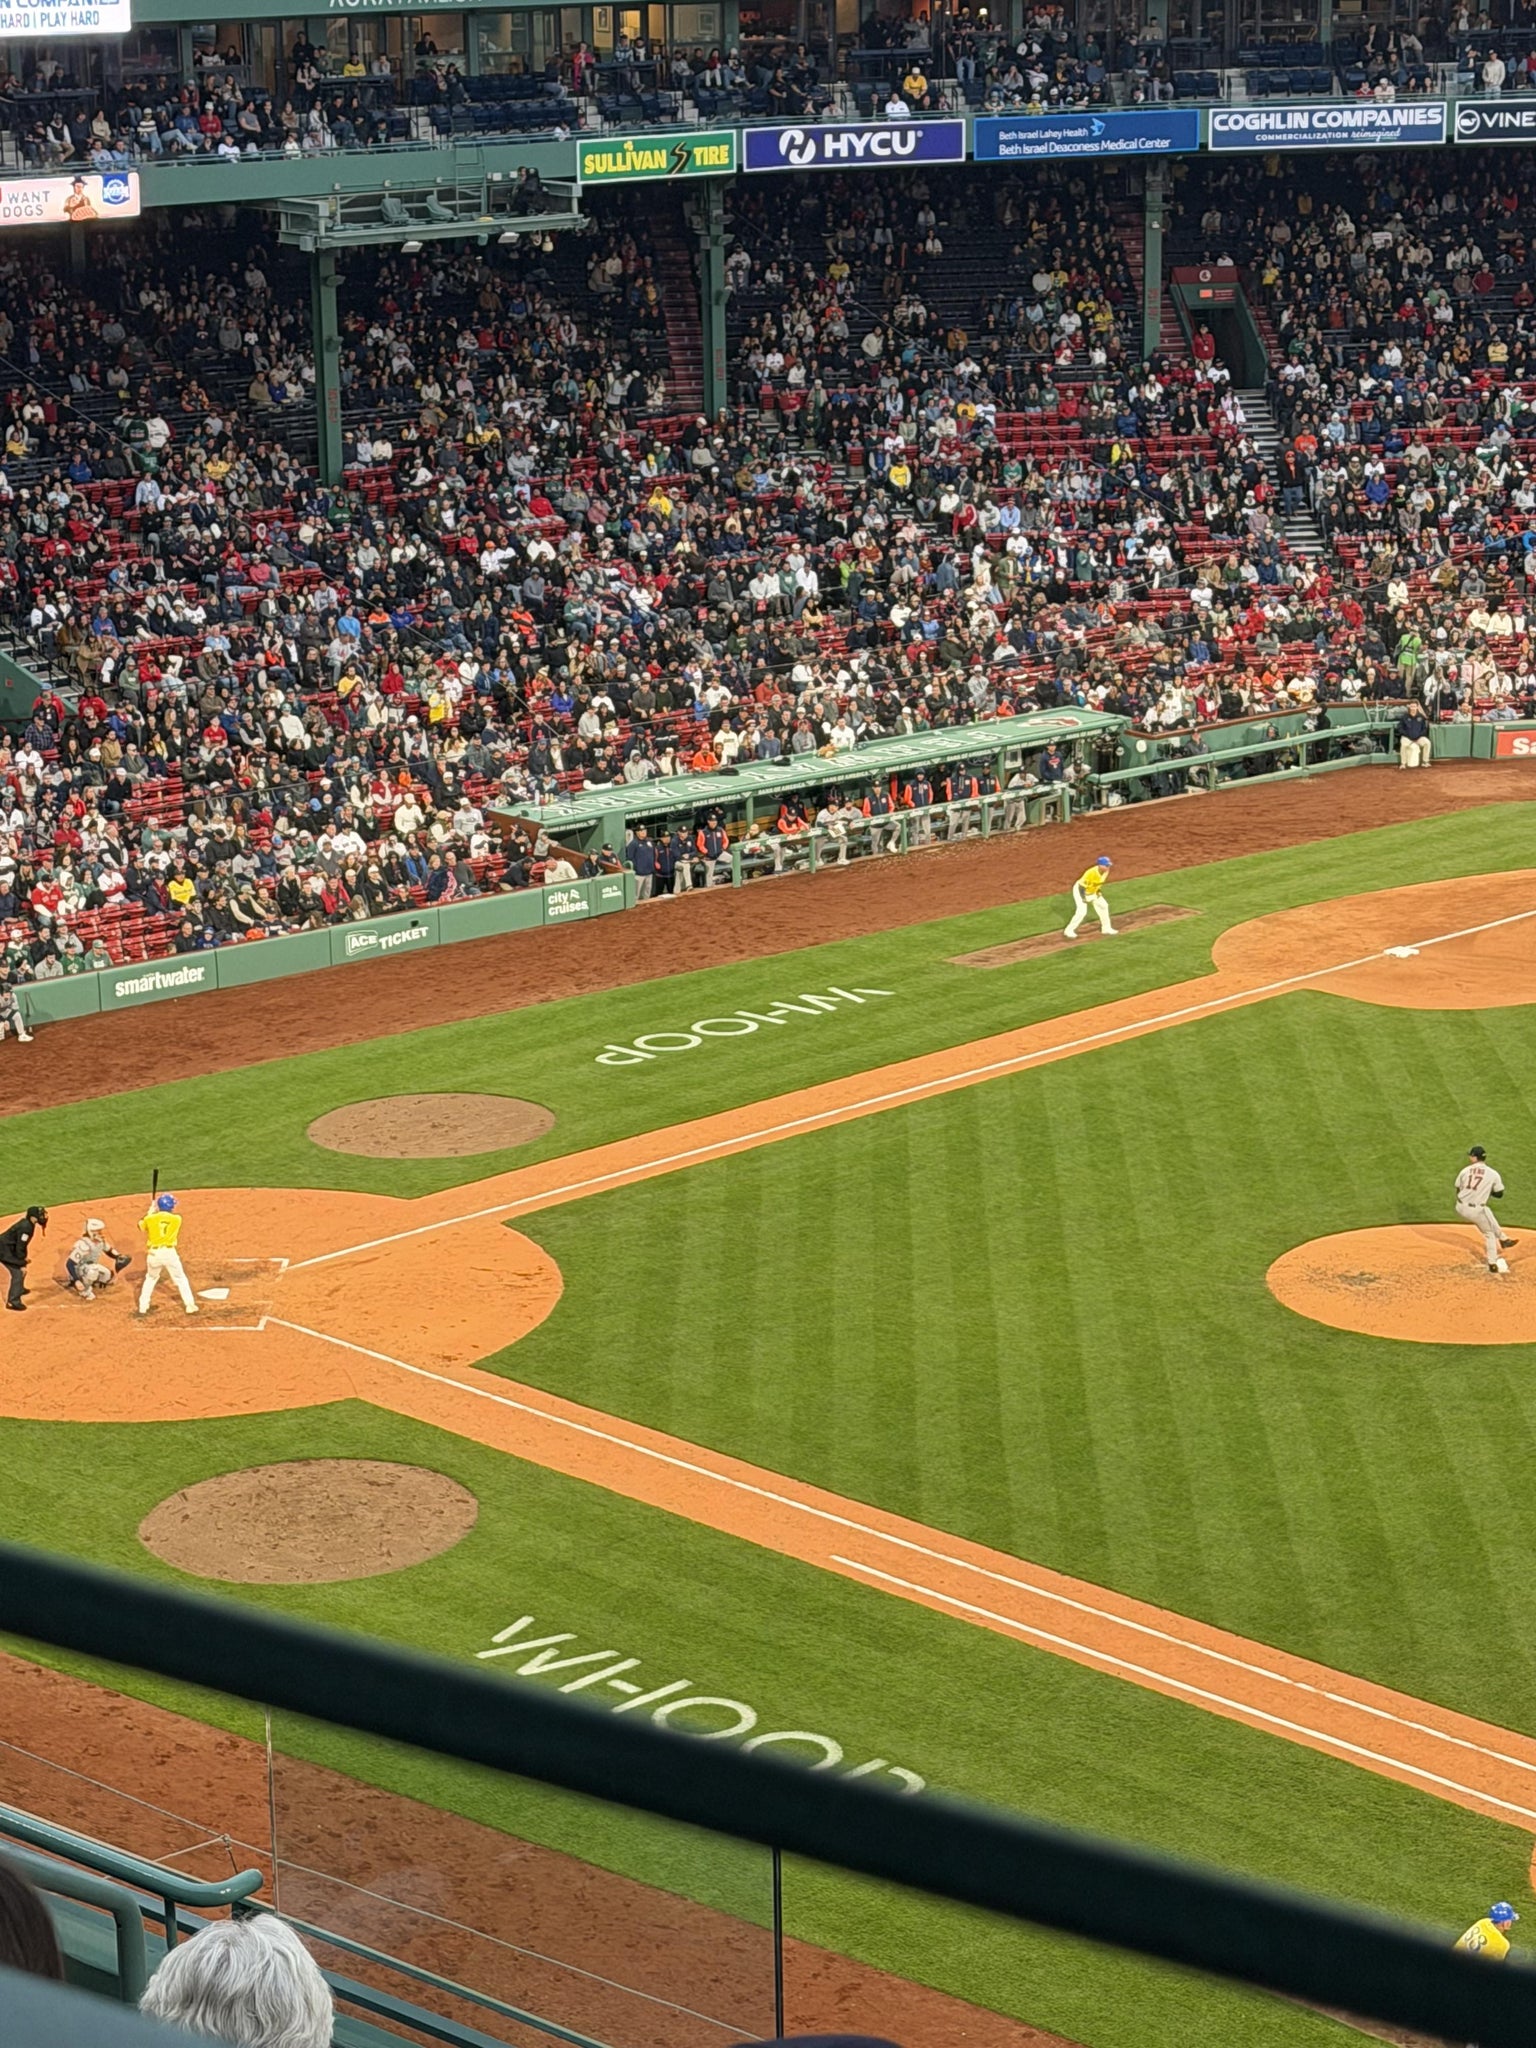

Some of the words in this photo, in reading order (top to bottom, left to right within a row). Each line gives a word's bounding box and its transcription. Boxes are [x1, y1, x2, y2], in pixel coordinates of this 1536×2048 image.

[0, 13, 30, 28] HARD
[40, 11, 67, 27] PLAY
[71, 10, 100, 26] HARD
[1213, 111, 1309, 131] COGHLIN
[1312, 107, 1443, 128] COMPANIES
[1481, 111, 1536, 128] VINE
[999, 131, 1017, 140] Beth
[1018, 130, 1039, 139] Israel
[1039, 129, 1062, 139] Lahey
[1063, 127, 1089, 137] Health
[1255, 131, 1349, 142] COMMERCIALIZATION
[1351, 128, 1401, 142] reimagined
[824, 130, 916, 158] HYCU
[999, 143, 1021, 155] Beth
[1022, 142, 1048, 154] Israel
[1049, 141, 1099, 153] Deaconess
[1100, 138, 1137, 151] Medical
[1138, 137, 1171, 149] Center
[584, 146, 667, 174] SULLIVAN
[693, 145, 730, 166] TIRE
[8, 190, 51, 204] WANT
[3, 204, 44, 218] DOGS
[716, 795, 742, 803] AMERICA
[648, 806, 675, 816] AMERICA
[548, 891, 568, 904] city
[548, 901, 588, 916] cruises
[351, 935, 378, 949] ACE
[379, 926, 429, 950] TICKET
[115, 966, 205, 997] smartwater
[595, 986, 896, 1065] WHOOP
[1466, 1174, 1483, 1190] 17
[475, 1615, 926, 1797] WHOOP
